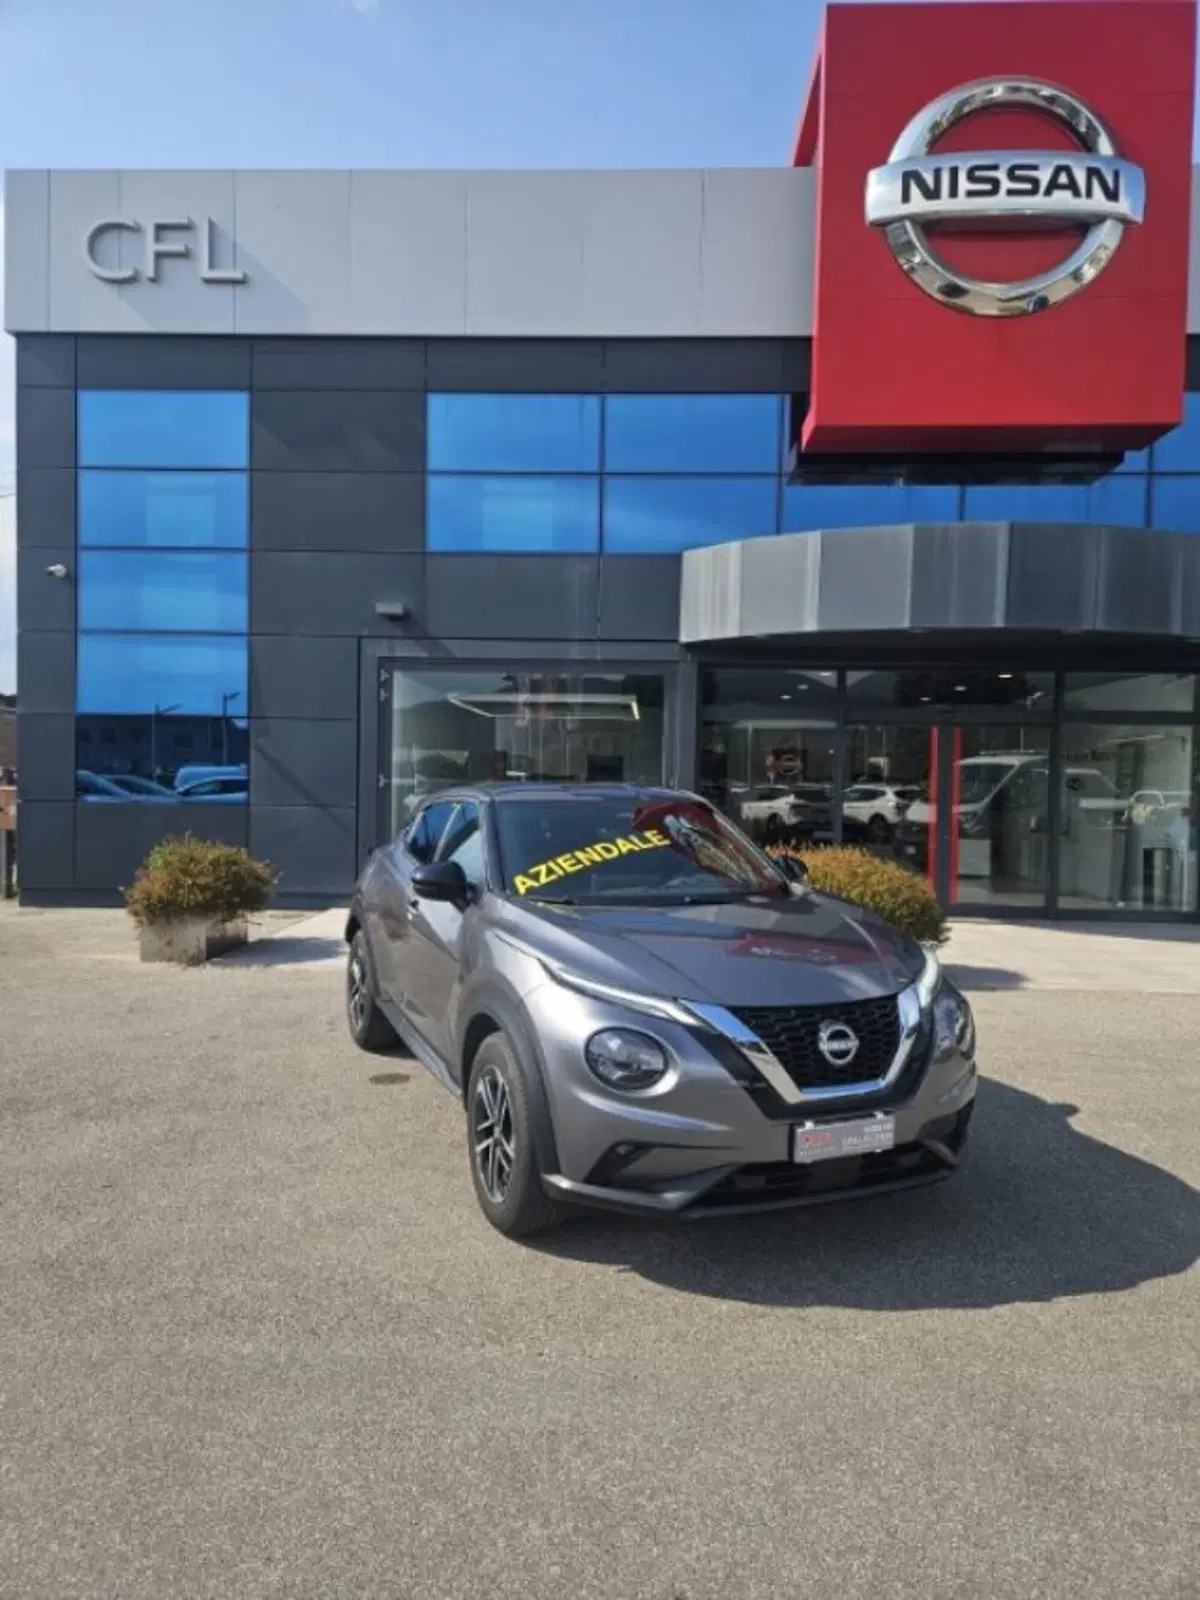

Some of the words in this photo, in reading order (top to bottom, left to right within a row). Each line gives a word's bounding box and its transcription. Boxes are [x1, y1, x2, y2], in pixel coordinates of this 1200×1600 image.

[901, 164, 1120, 204] NISSAN
[83, 216, 248, 284] CFL
[513, 829, 672, 896] AZIENDALE
